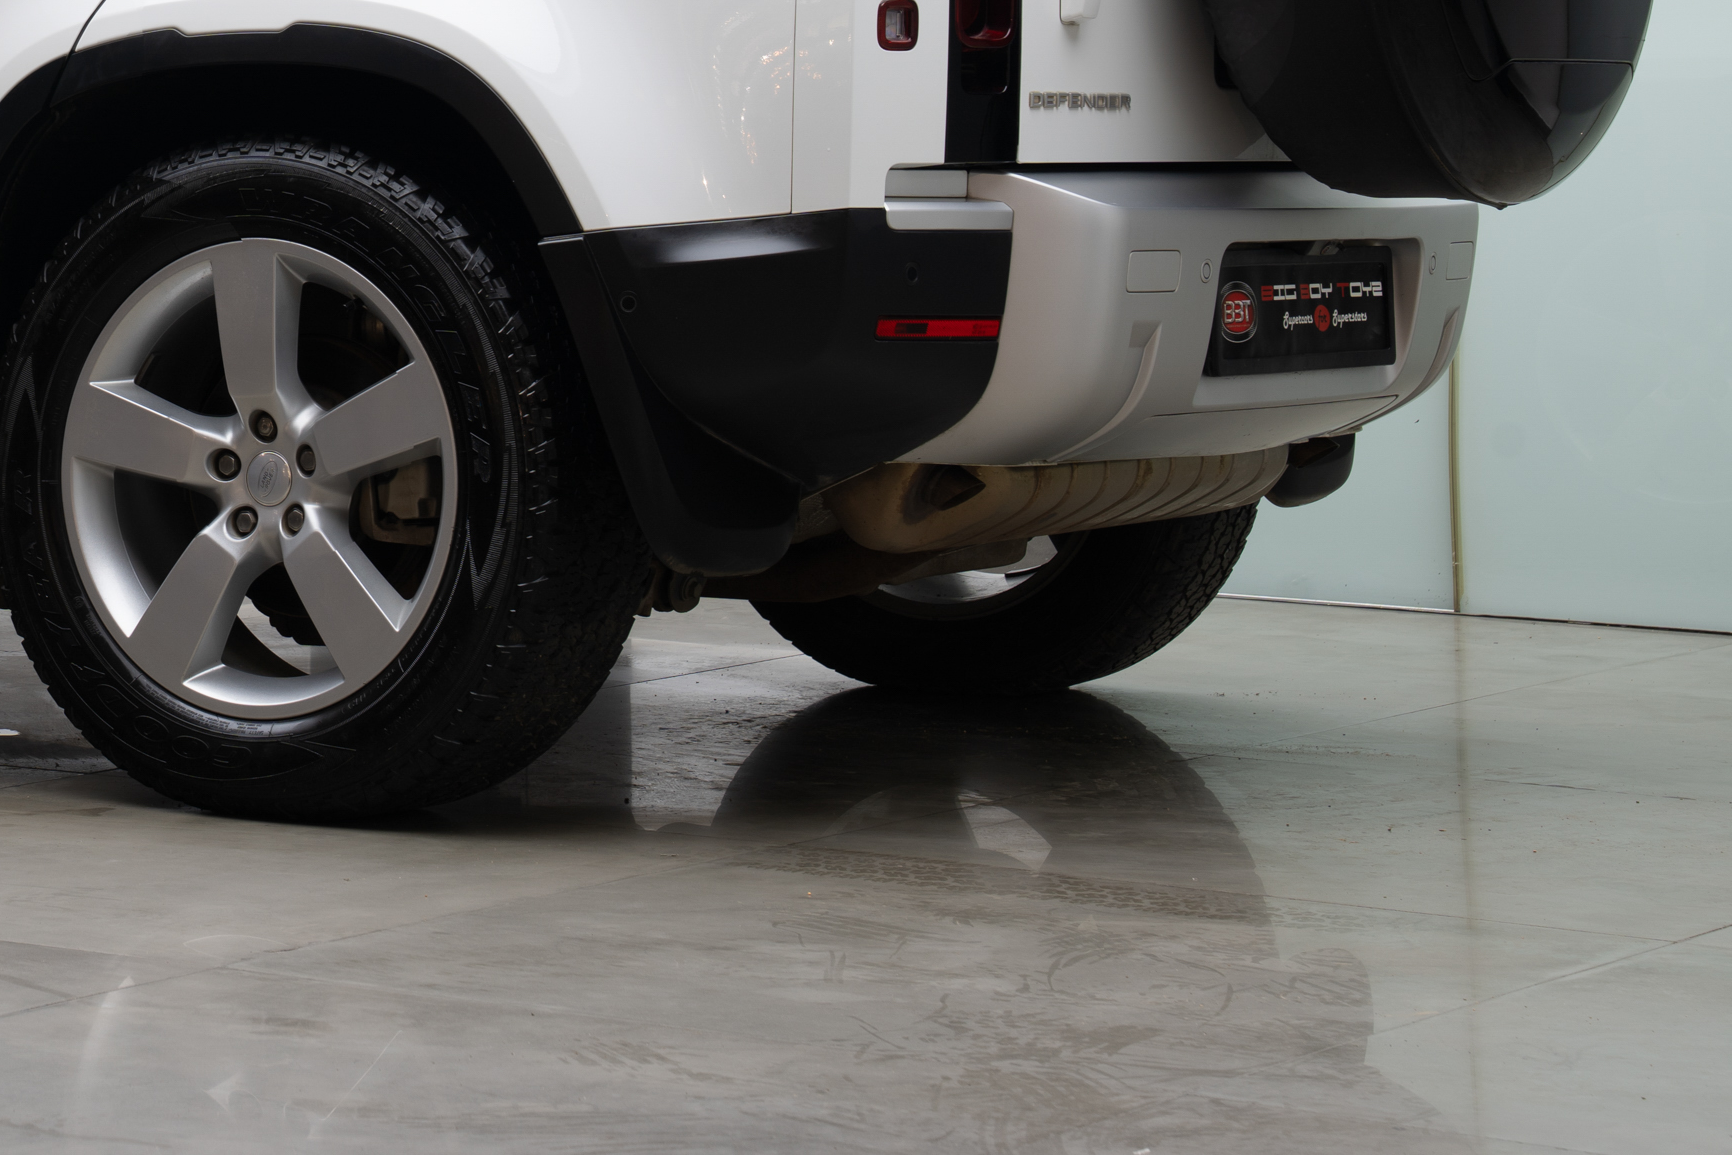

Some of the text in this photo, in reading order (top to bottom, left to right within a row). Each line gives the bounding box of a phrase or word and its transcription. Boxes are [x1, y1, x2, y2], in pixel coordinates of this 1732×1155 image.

[1028, 91, 1132, 111] DEFENDER
[1261, 281, 1383, 301] BIG BOY TOYZ
[1224, 299, 1251, 324] BBT
[1283, 311, 1314, 331] Supercars
[1332, 309, 1368, 328] Superstars
